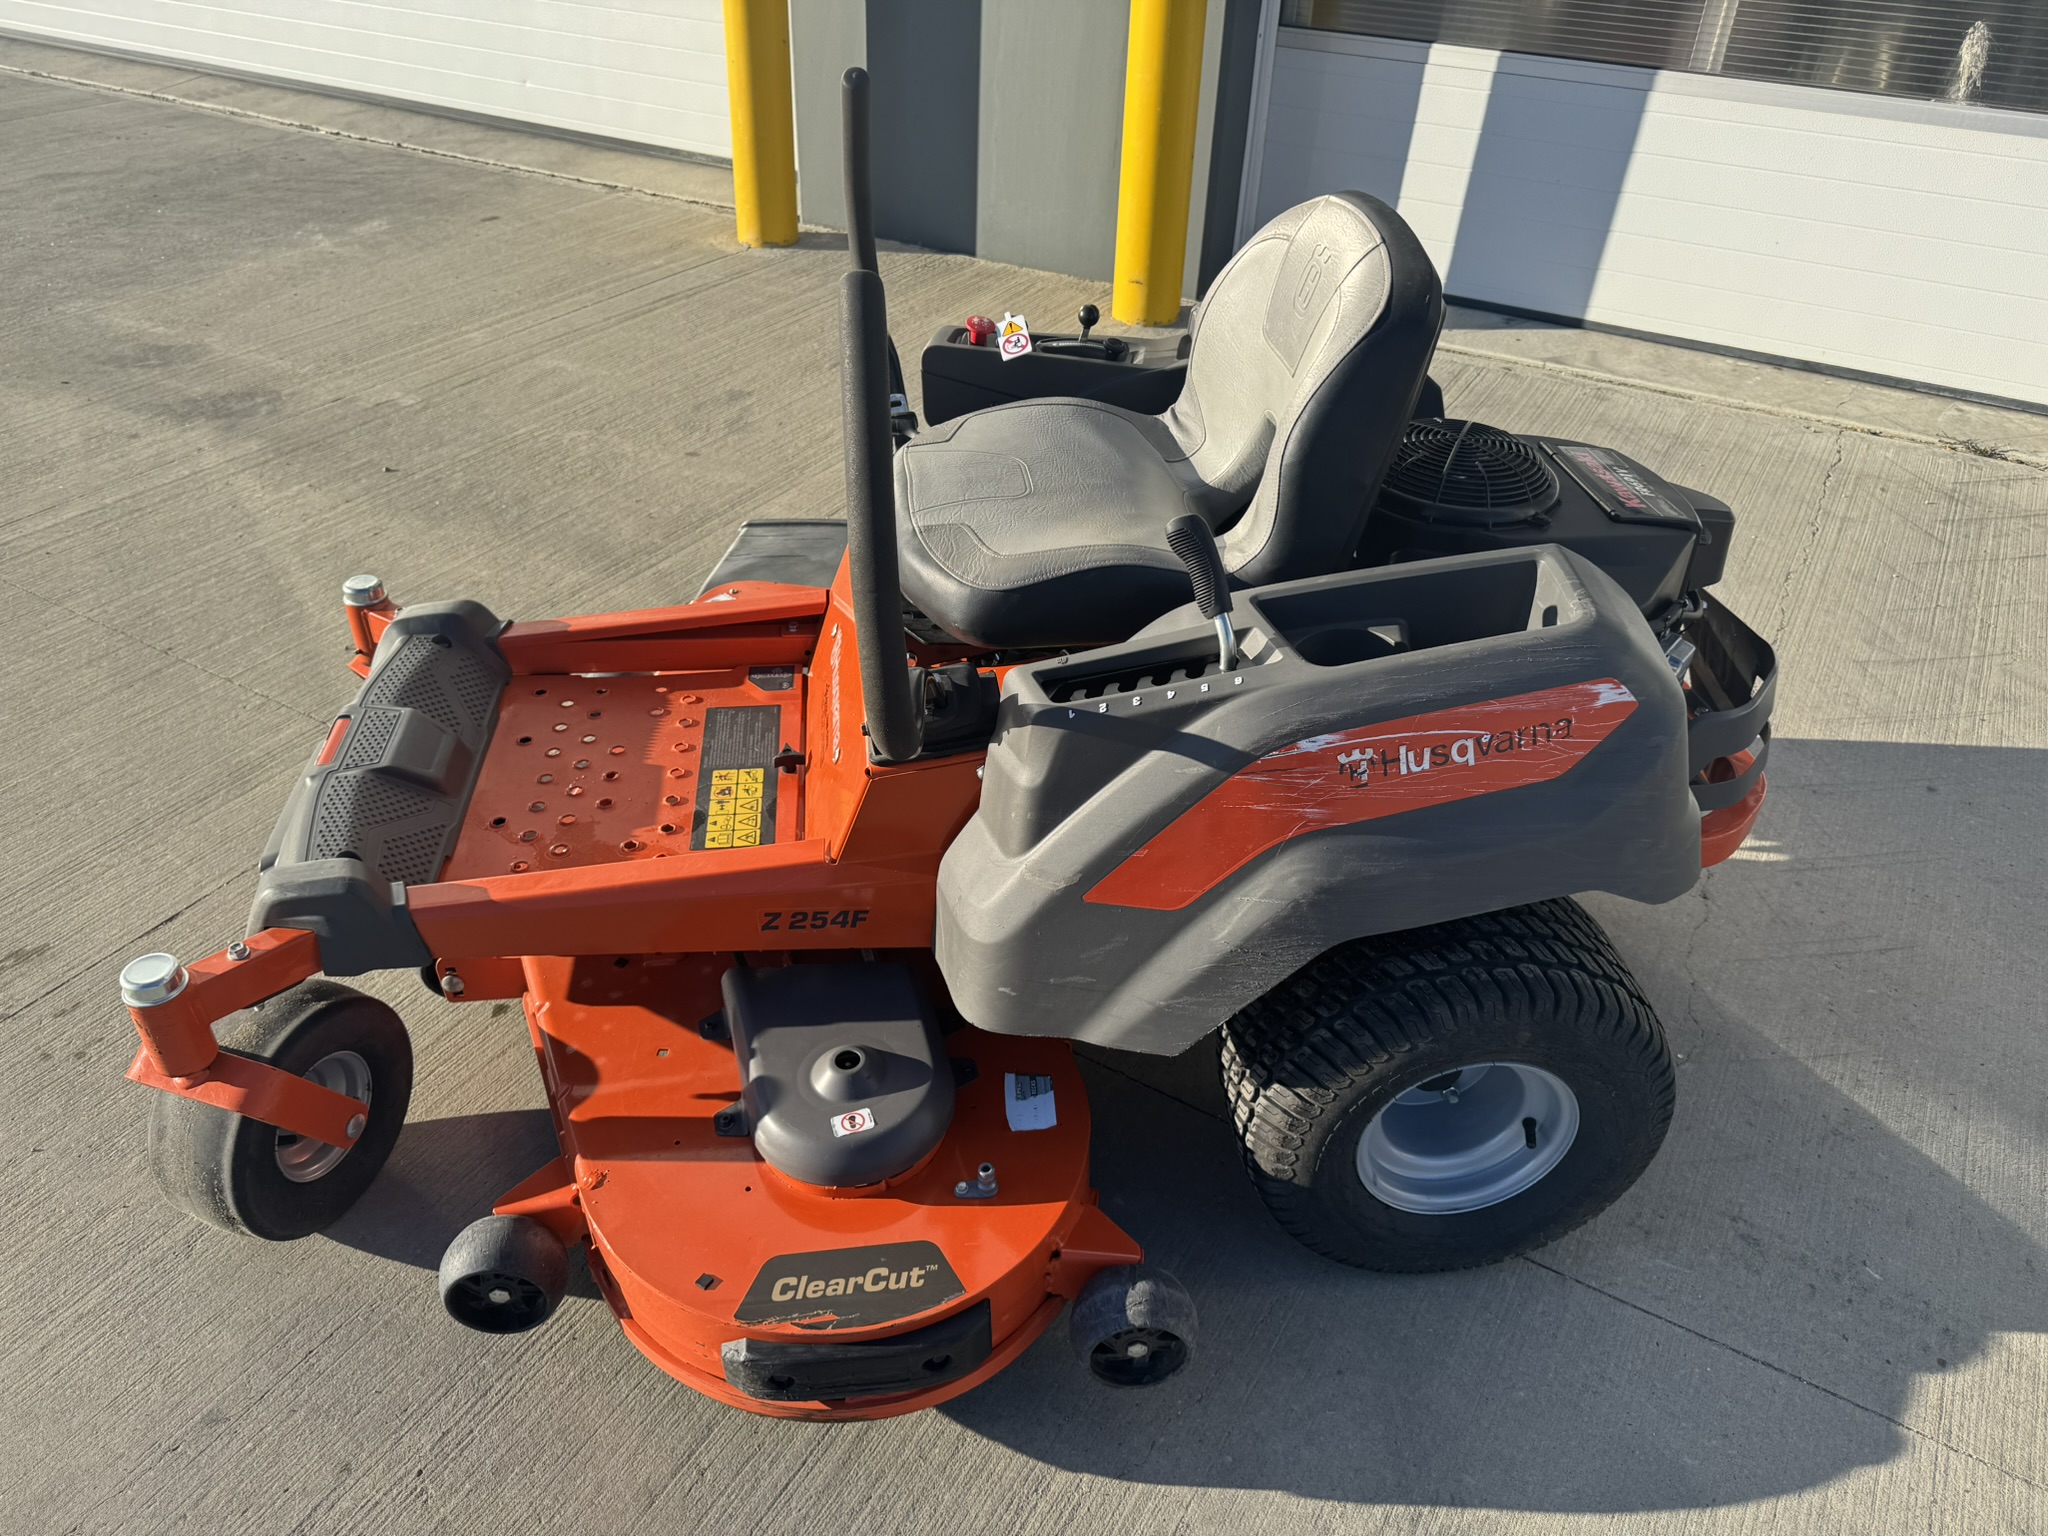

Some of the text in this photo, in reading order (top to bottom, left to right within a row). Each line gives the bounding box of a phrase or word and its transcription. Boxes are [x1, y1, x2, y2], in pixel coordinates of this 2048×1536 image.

[1576, 451, 1647, 509] Kawasaki
[1069, 676, 1244, 719] 1 2 3 4 5 6
[1380, 716, 1574, 778] Husqvarna
[761, 909, 869, 931] Z 254F
